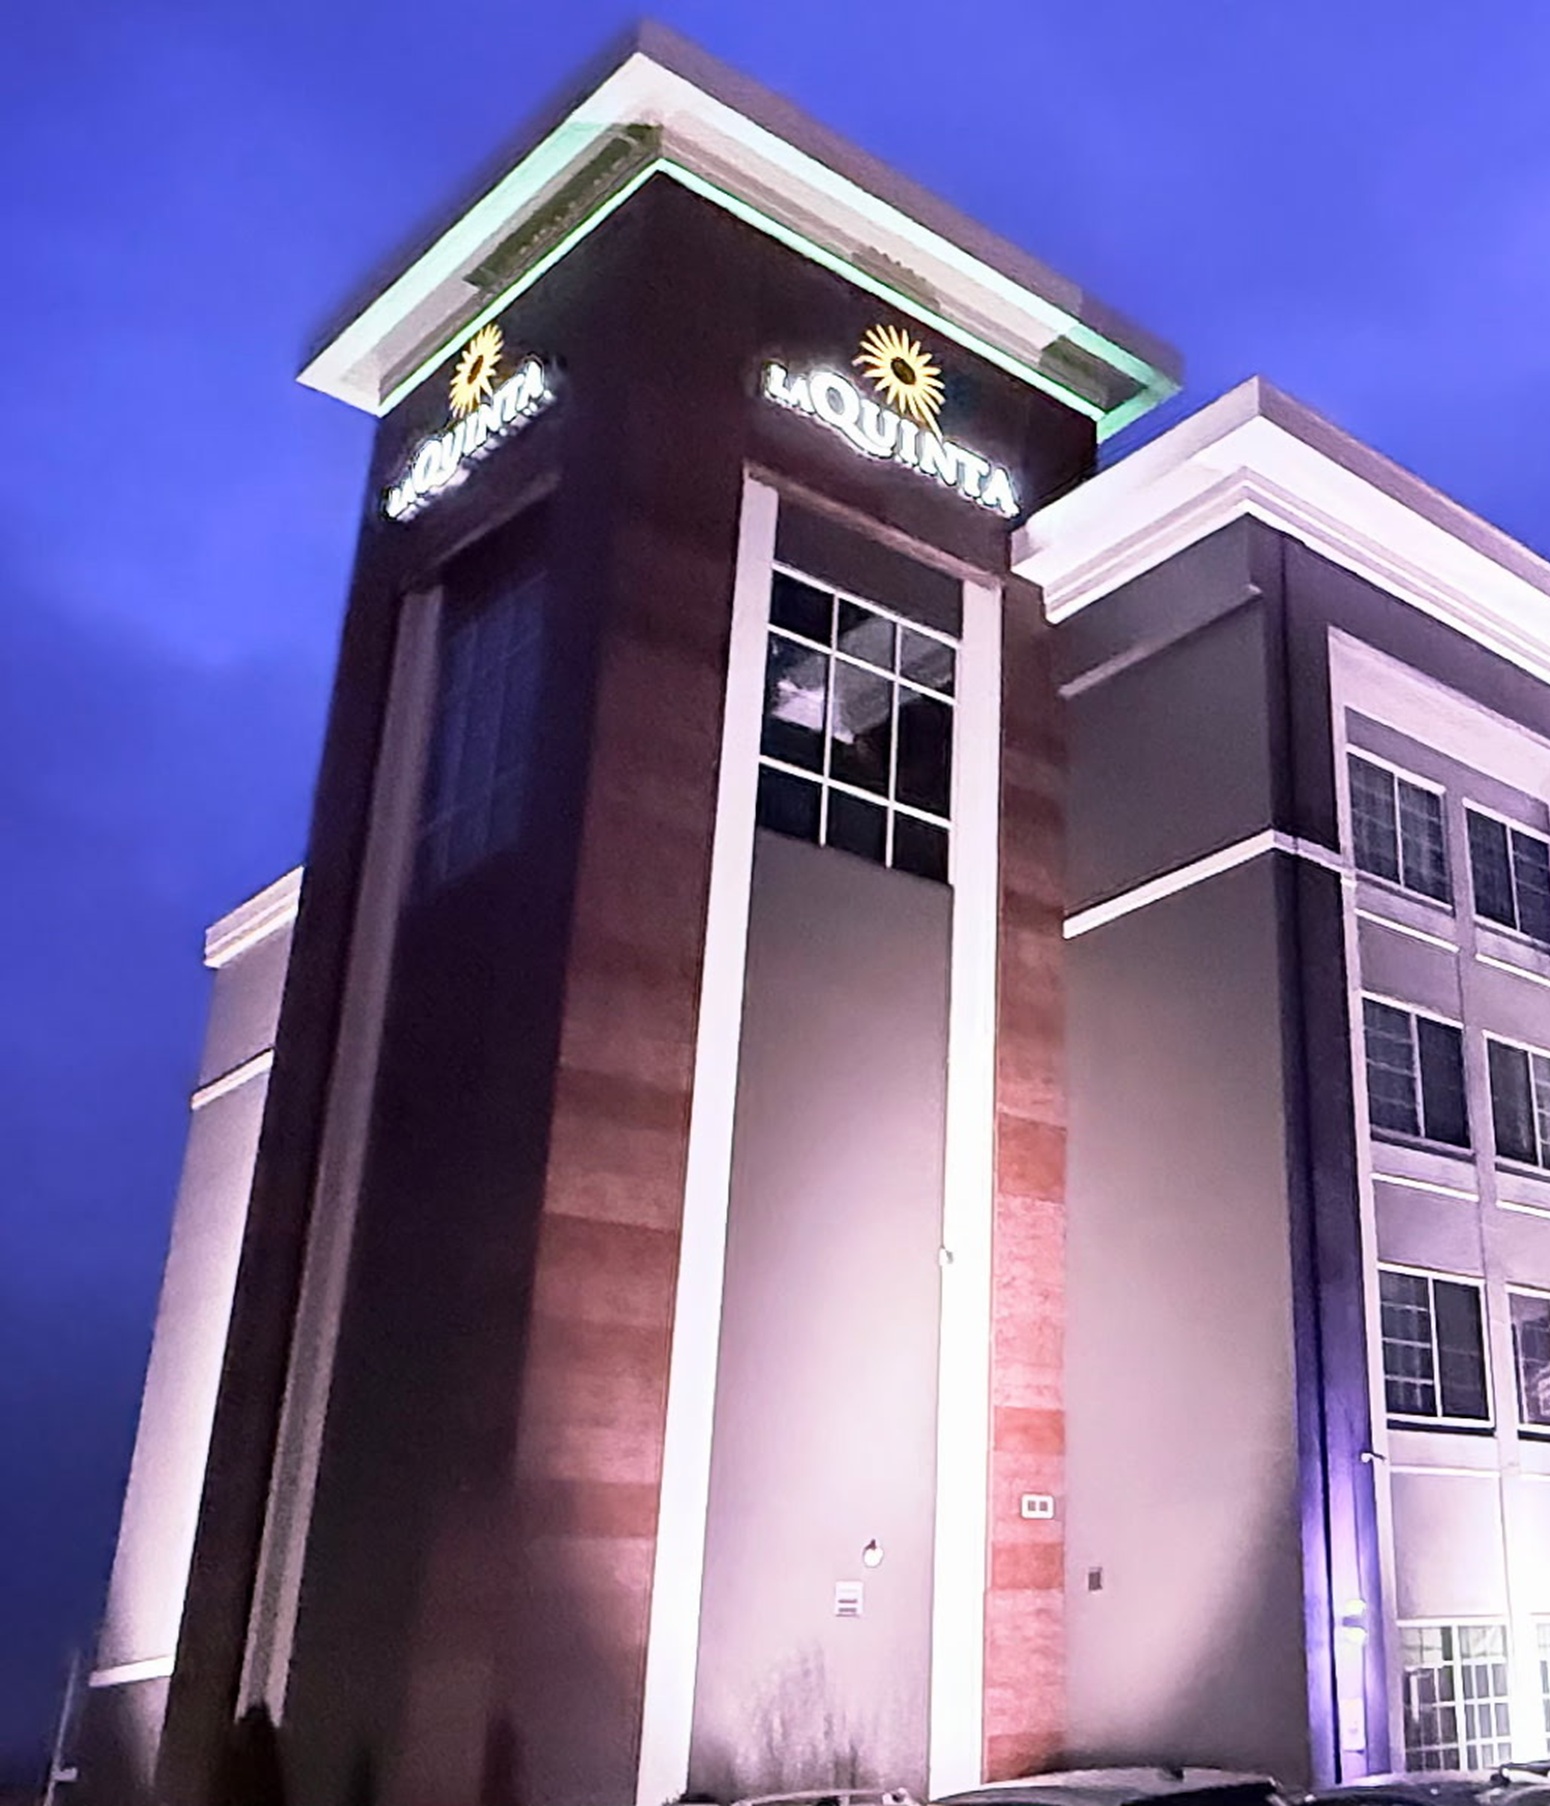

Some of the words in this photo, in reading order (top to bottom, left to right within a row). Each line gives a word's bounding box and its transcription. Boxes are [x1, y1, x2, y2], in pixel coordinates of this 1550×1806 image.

[386, 477, 417, 517] LA
[412, 360, 546, 494] QUINTA
[764, 362, 815, 415] LA
[809, 370, 1020, 518] QUINTA
